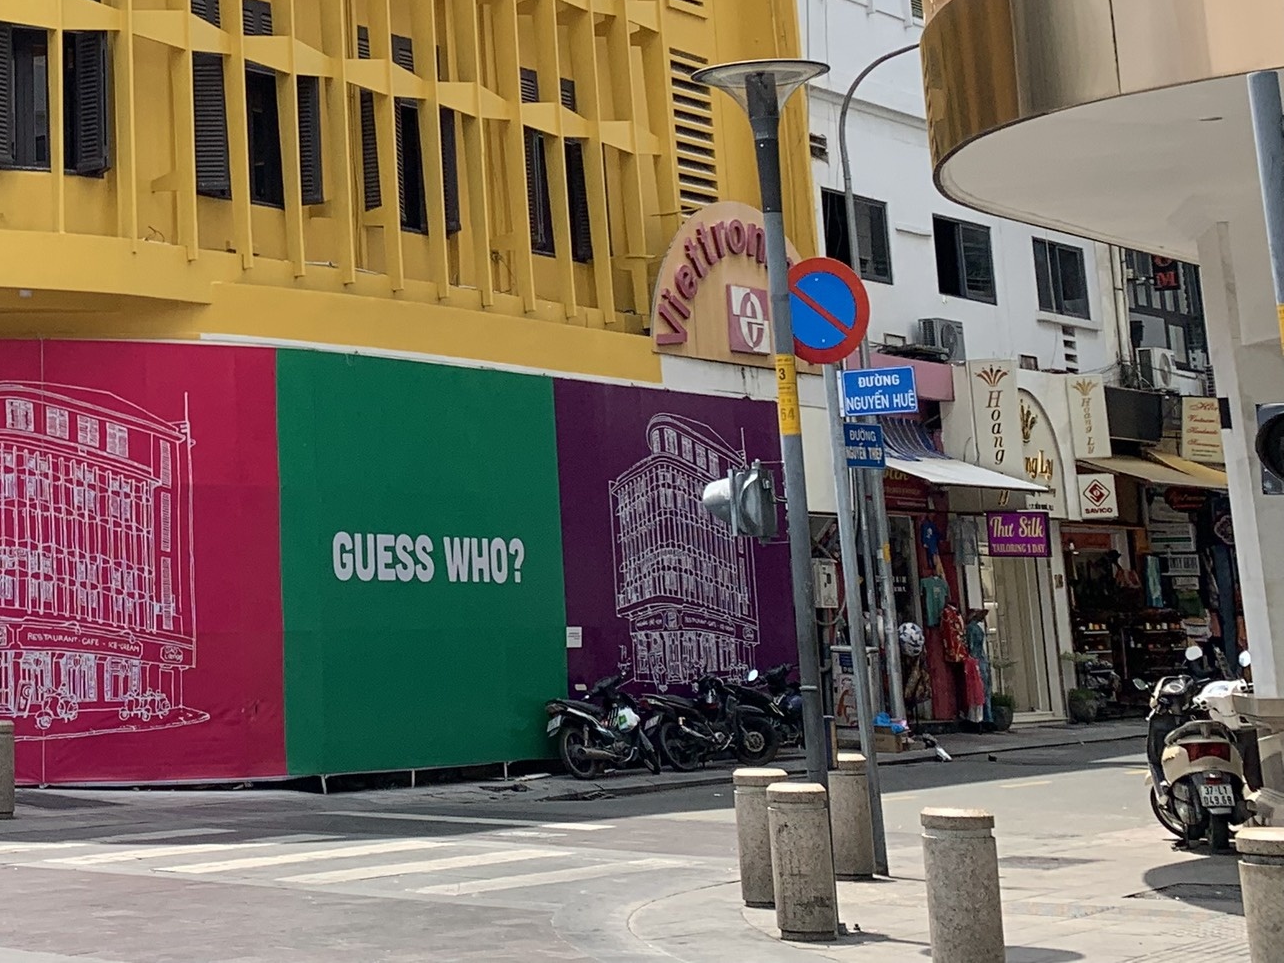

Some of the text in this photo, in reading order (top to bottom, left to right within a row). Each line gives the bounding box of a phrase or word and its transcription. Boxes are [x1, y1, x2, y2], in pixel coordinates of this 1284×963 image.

[656, 219, 767, 346] Viettron
[779, 368, 786, 380] 3
[857, 373, 900, 388] ĐƯỜNG
[846, 389, 916, 411] NGUYỄN HUỆ
[849, 428, 877, 442] ĐƯỜNG
[1019, 515, 1044, 538] Silk
[332, 531, 525, 584] GUESS WHO?
[27, 632, 76, 643] RESTAURANT
